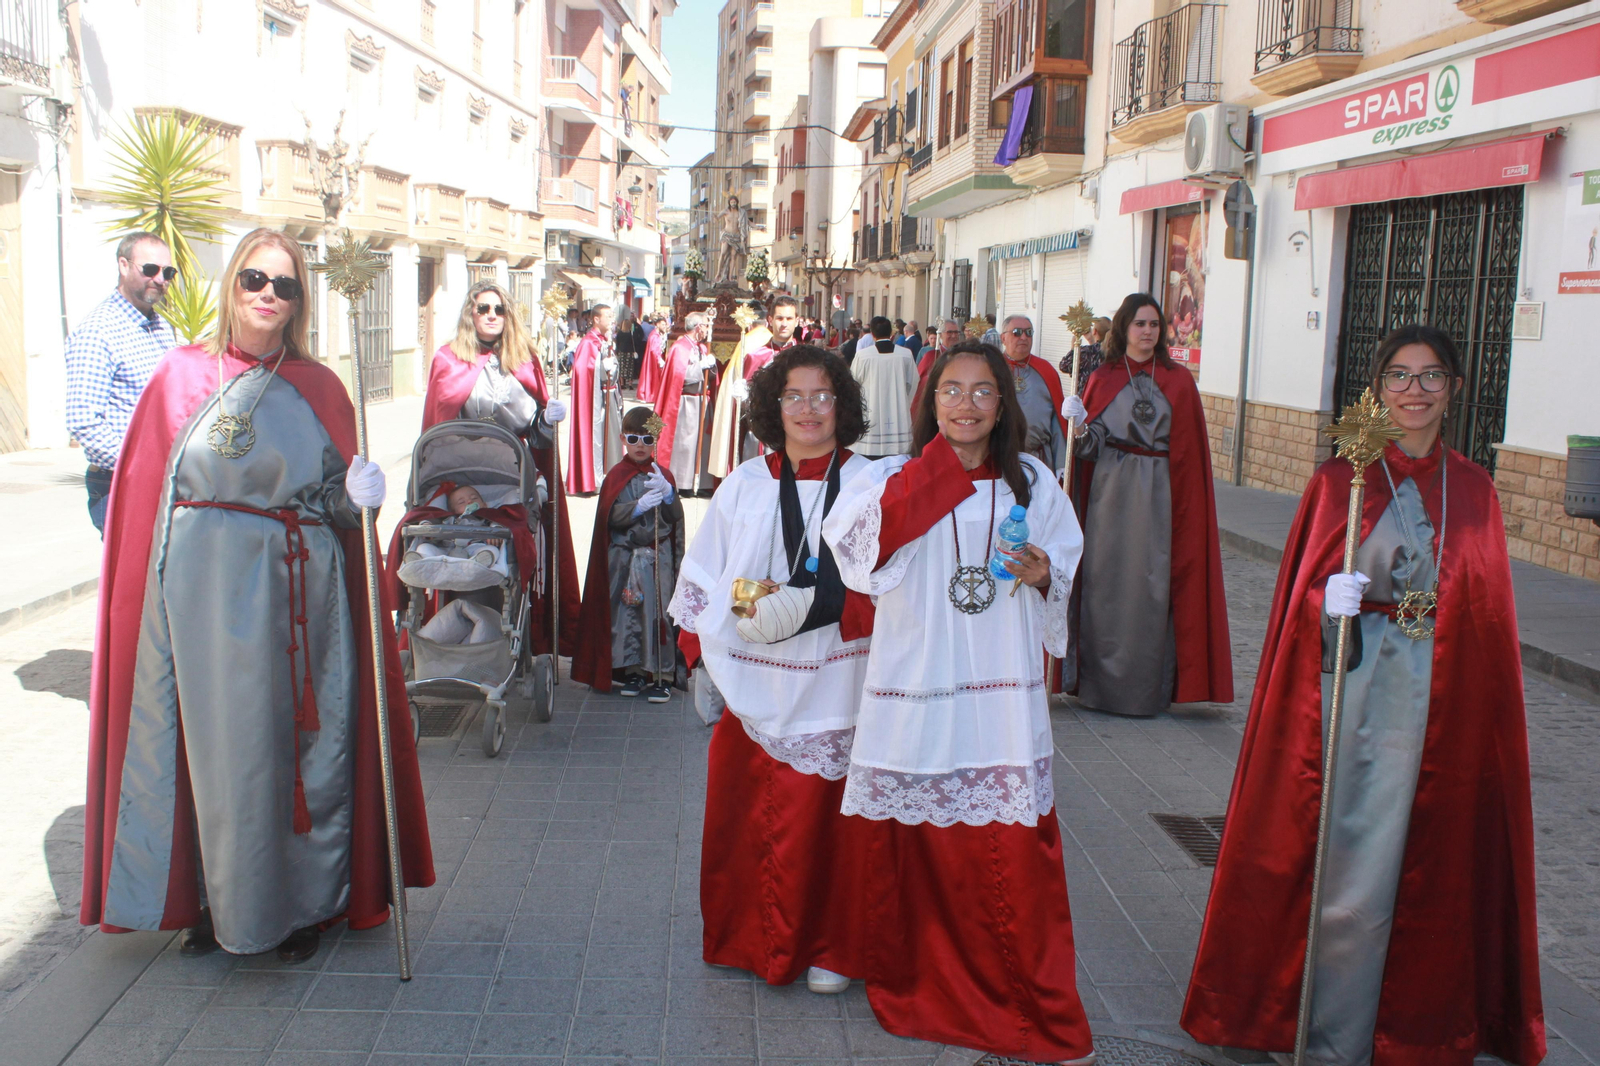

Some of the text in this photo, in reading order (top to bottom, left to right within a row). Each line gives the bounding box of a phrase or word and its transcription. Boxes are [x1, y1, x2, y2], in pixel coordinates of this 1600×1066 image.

[1344, 81, 1425, 128] SPAR
[1372, 114, 1453, 145] express
[1506, 167, 1522, 175] SPAR
